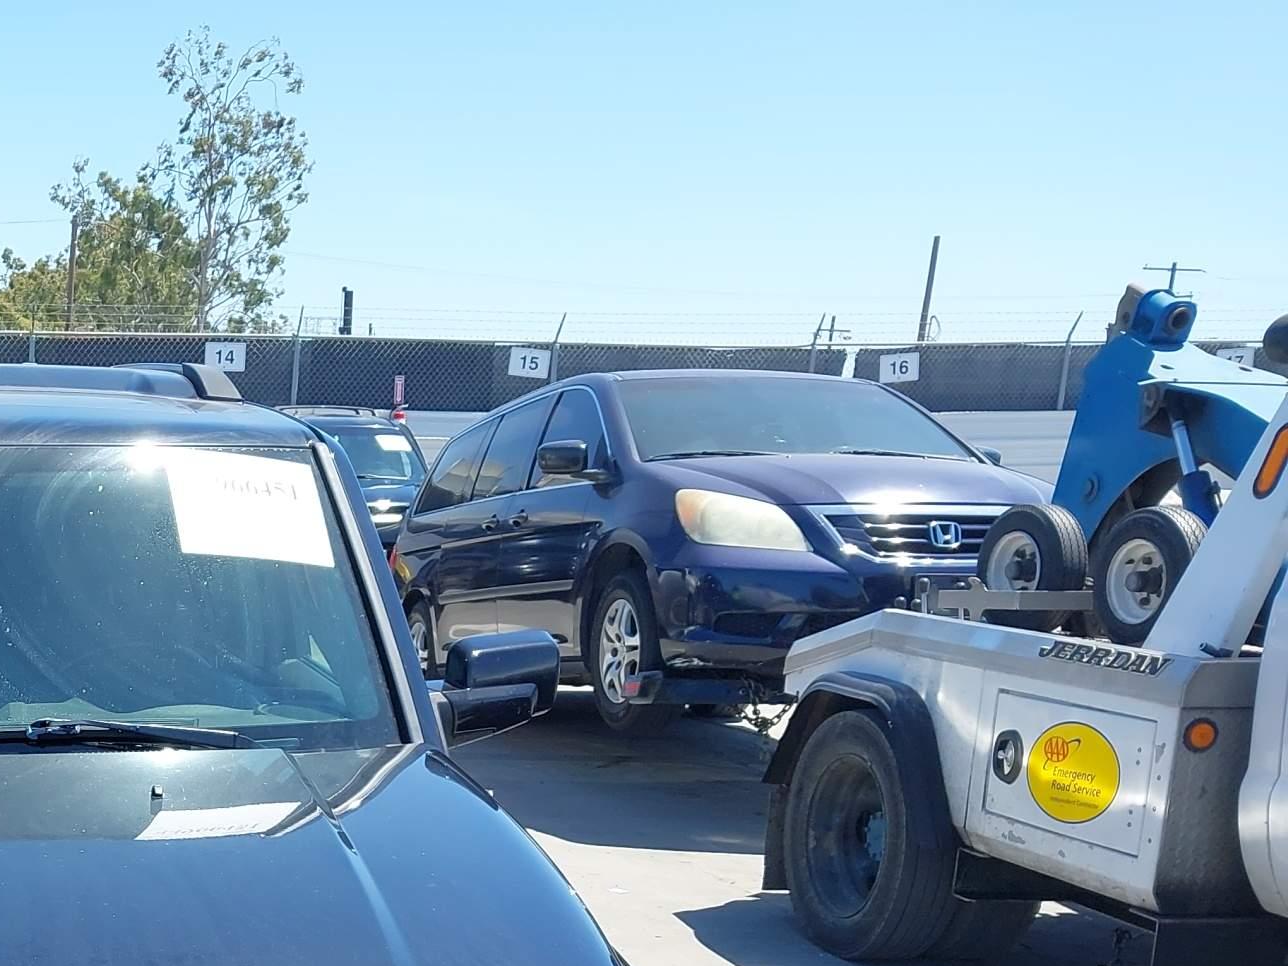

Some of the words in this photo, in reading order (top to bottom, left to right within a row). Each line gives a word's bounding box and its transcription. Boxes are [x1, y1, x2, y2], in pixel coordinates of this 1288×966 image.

[215, 349, 235, 365] 14
[520, 354, 540, 371] 15
[889, 360, 909, 376] 16
[1052, 766, 1097, 784] Emergency
[1051, 779, 1071, 792] Road
[1071, 781, 1102, 798] Service
